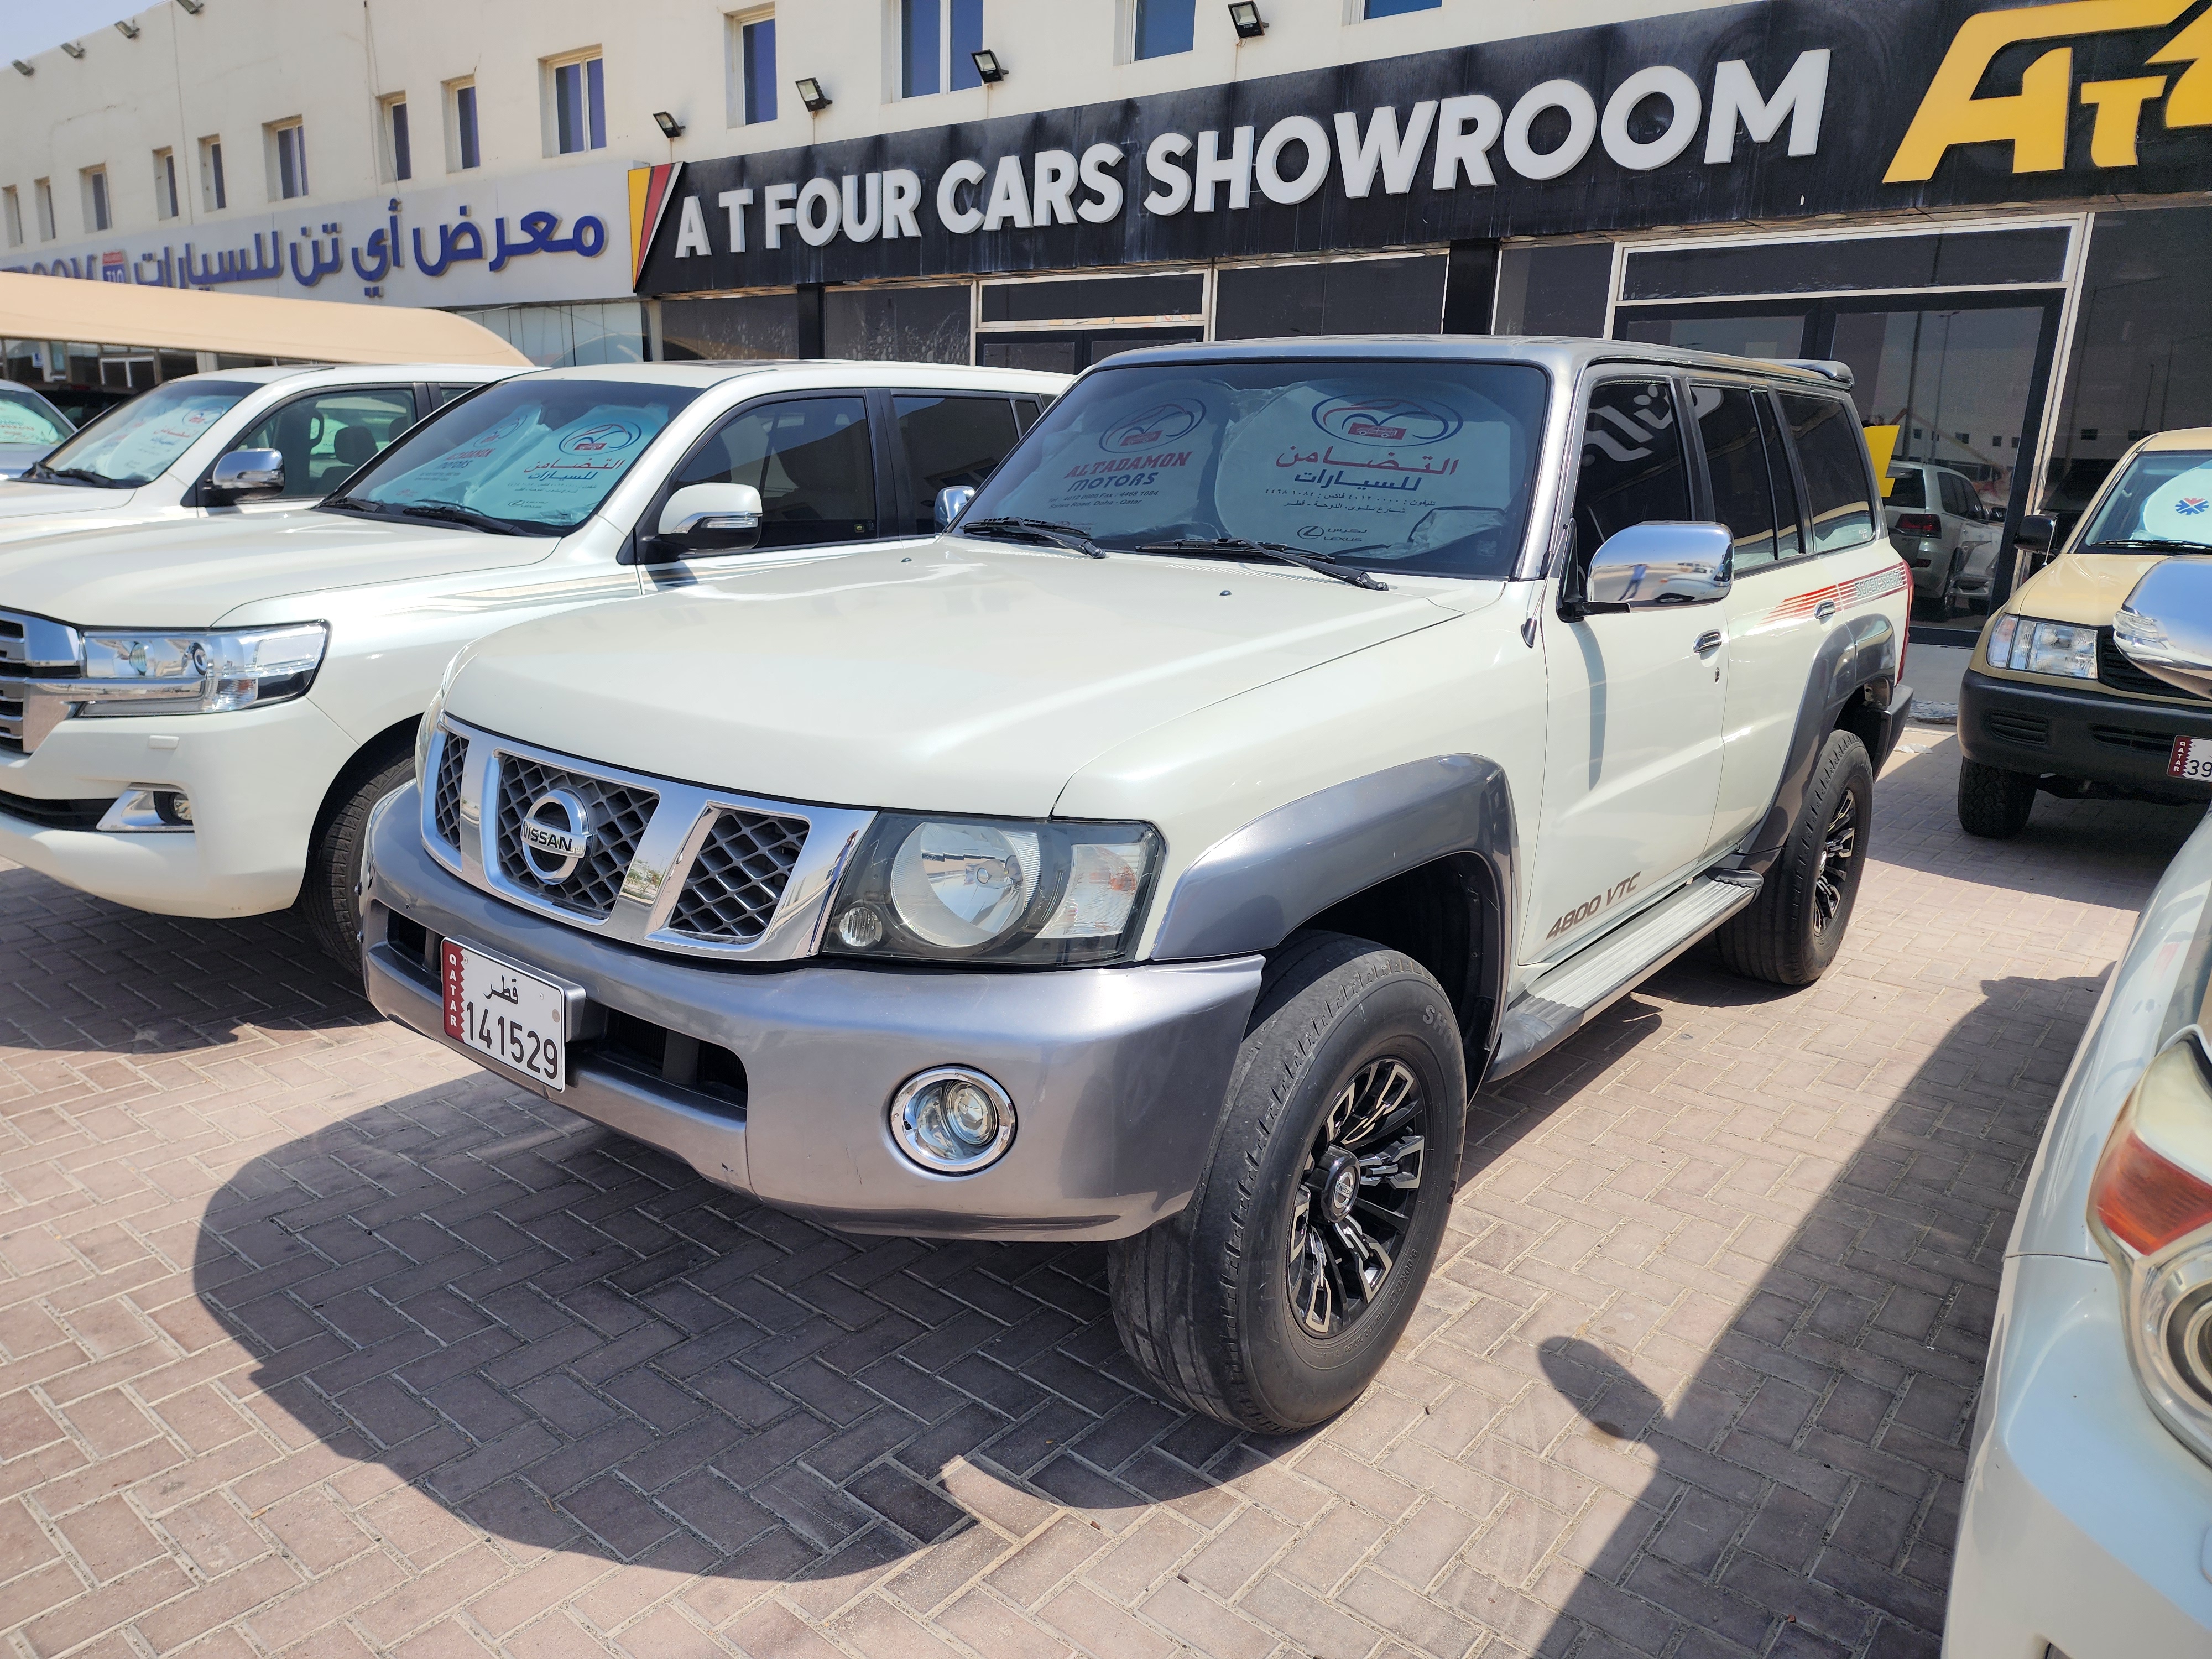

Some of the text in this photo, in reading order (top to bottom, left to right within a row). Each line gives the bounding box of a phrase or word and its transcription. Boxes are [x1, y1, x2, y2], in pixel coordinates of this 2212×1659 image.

[675, 48, 1831, 259] A T FOUR CARS SHOWROOM
[134, 197, 608, 297] معرض أي تن للسيارات
[1063, 451, 1193, 479] ALTADAMON
[1276, 445, 1459, 476] التضامن
[1067, 472, 1159, 492] MOTORS
[1294, 469, 1422, 491] للسيارات
[1854, 575, 1881, 599] SUPER
[2173, 740, 2187, 773] QATAR
[521, 820, 573, 852] NISSAN
[1545, 870, 1642, 941] 4800 VTC
[448, 953, 458, 1028] QATAR
[483, 975, 519, 1005] قطر
[466, 1000, 559, 1081] 141529
